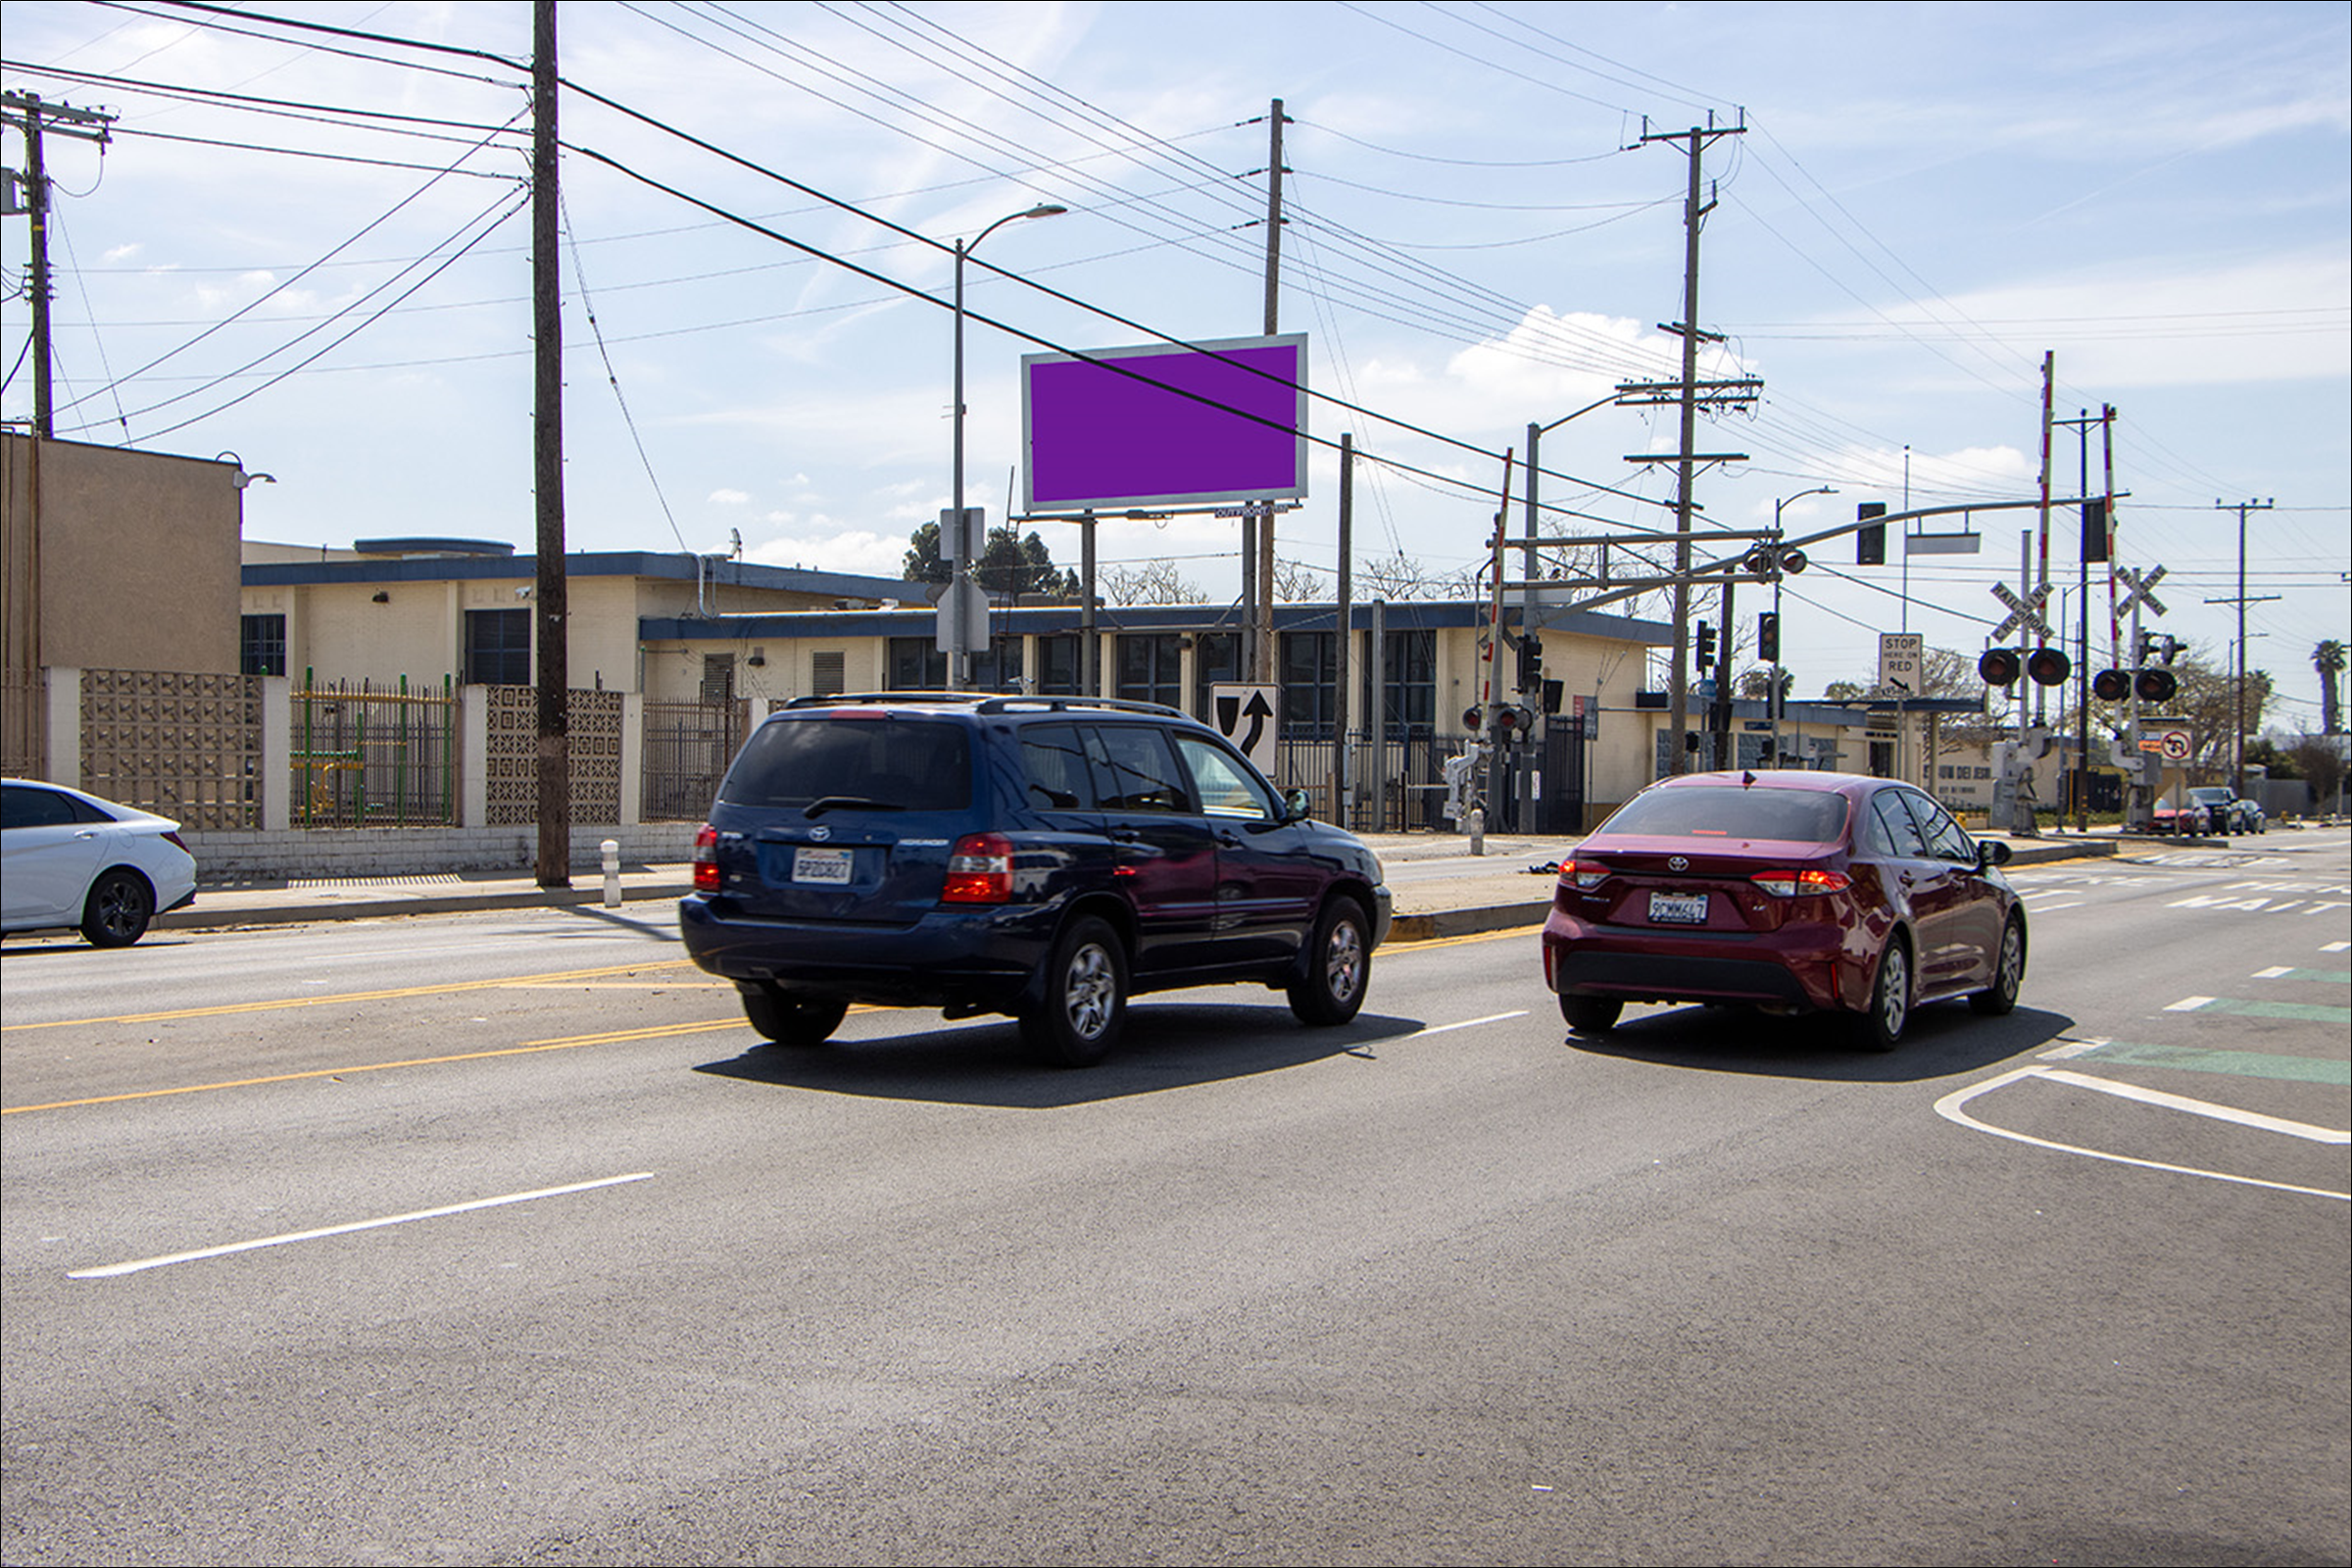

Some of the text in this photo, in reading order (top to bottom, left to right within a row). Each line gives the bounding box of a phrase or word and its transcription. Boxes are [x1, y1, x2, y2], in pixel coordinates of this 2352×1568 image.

[1993, 582, 2053, 642] CROSSING
[2023, 612, 2053, 639] ROAD
[1886, 638, 1917, 649] STOP
[1888, 661, 1913, 671] RED
[2163, 895, 2351, 915] WAIT
